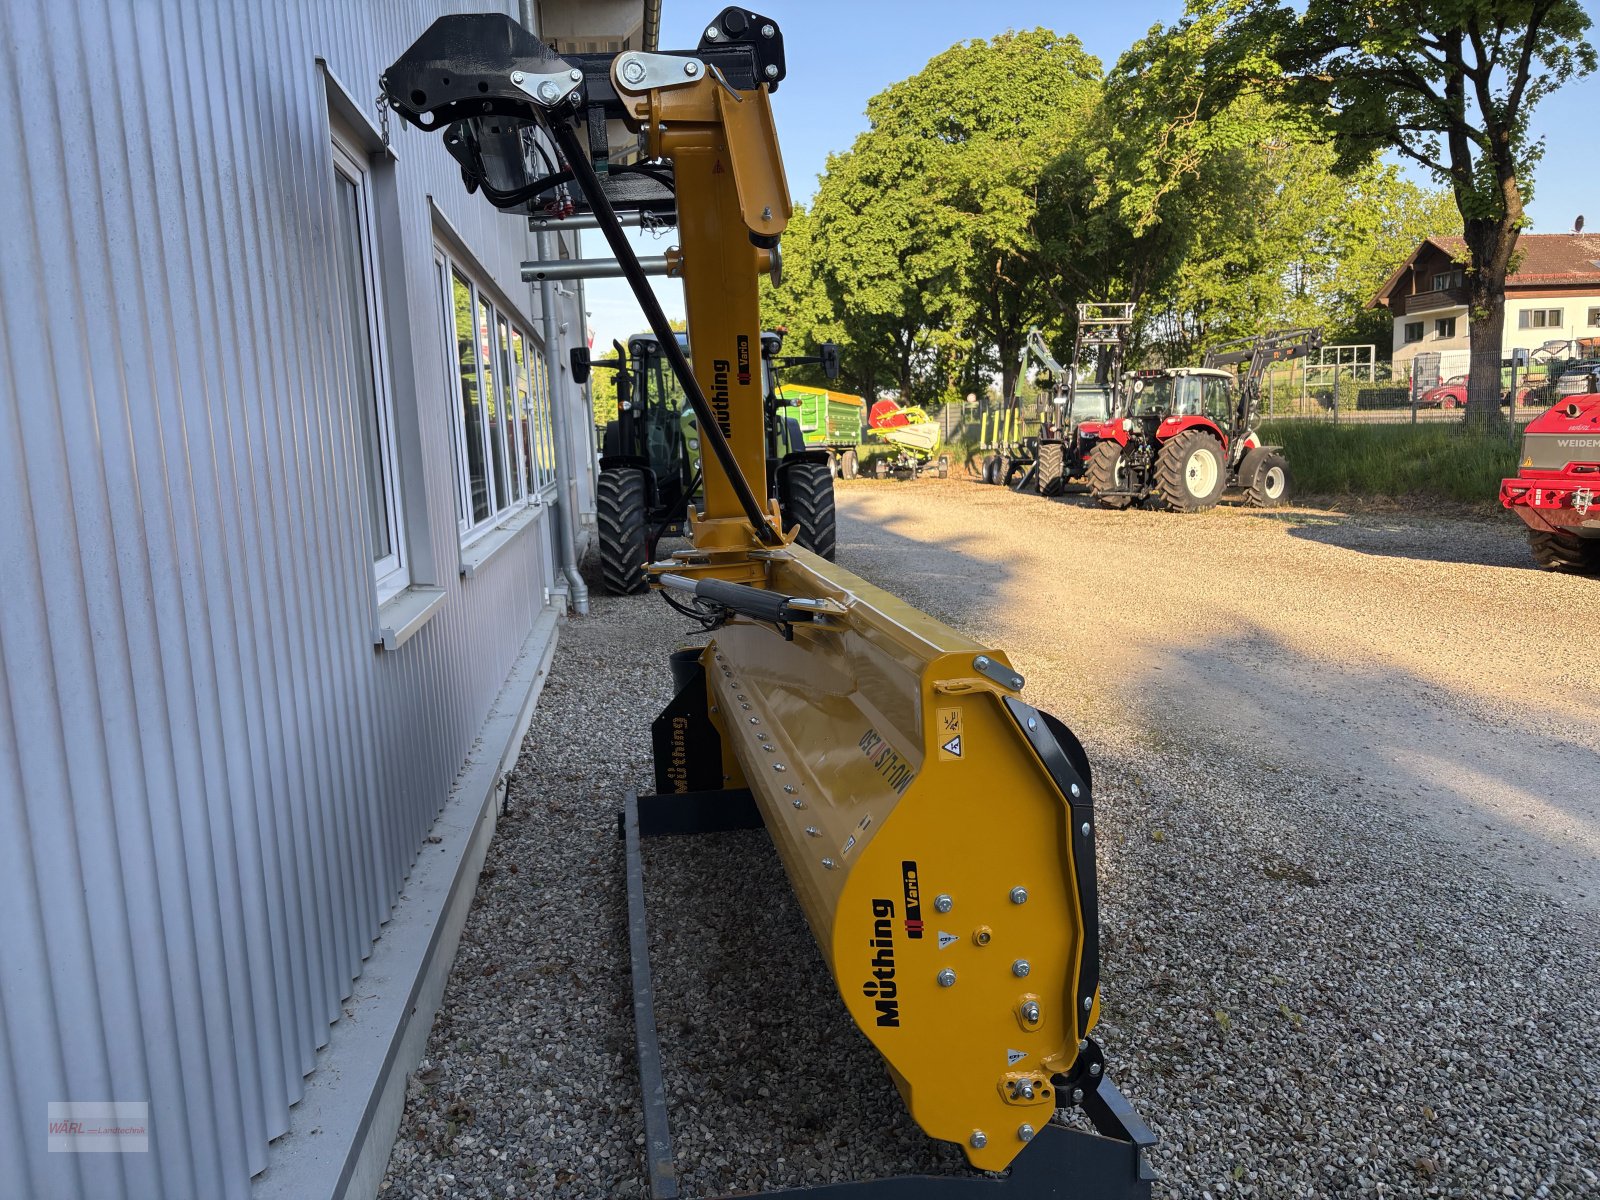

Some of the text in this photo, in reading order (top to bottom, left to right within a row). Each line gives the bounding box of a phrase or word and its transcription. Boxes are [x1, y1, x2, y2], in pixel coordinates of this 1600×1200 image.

[739, 341, 748, 366] Vario
[667, 717, 688, 794] Müthing
[905, 870, 918, 909] Vario
[863, 898, 900, 1028] Müthing
